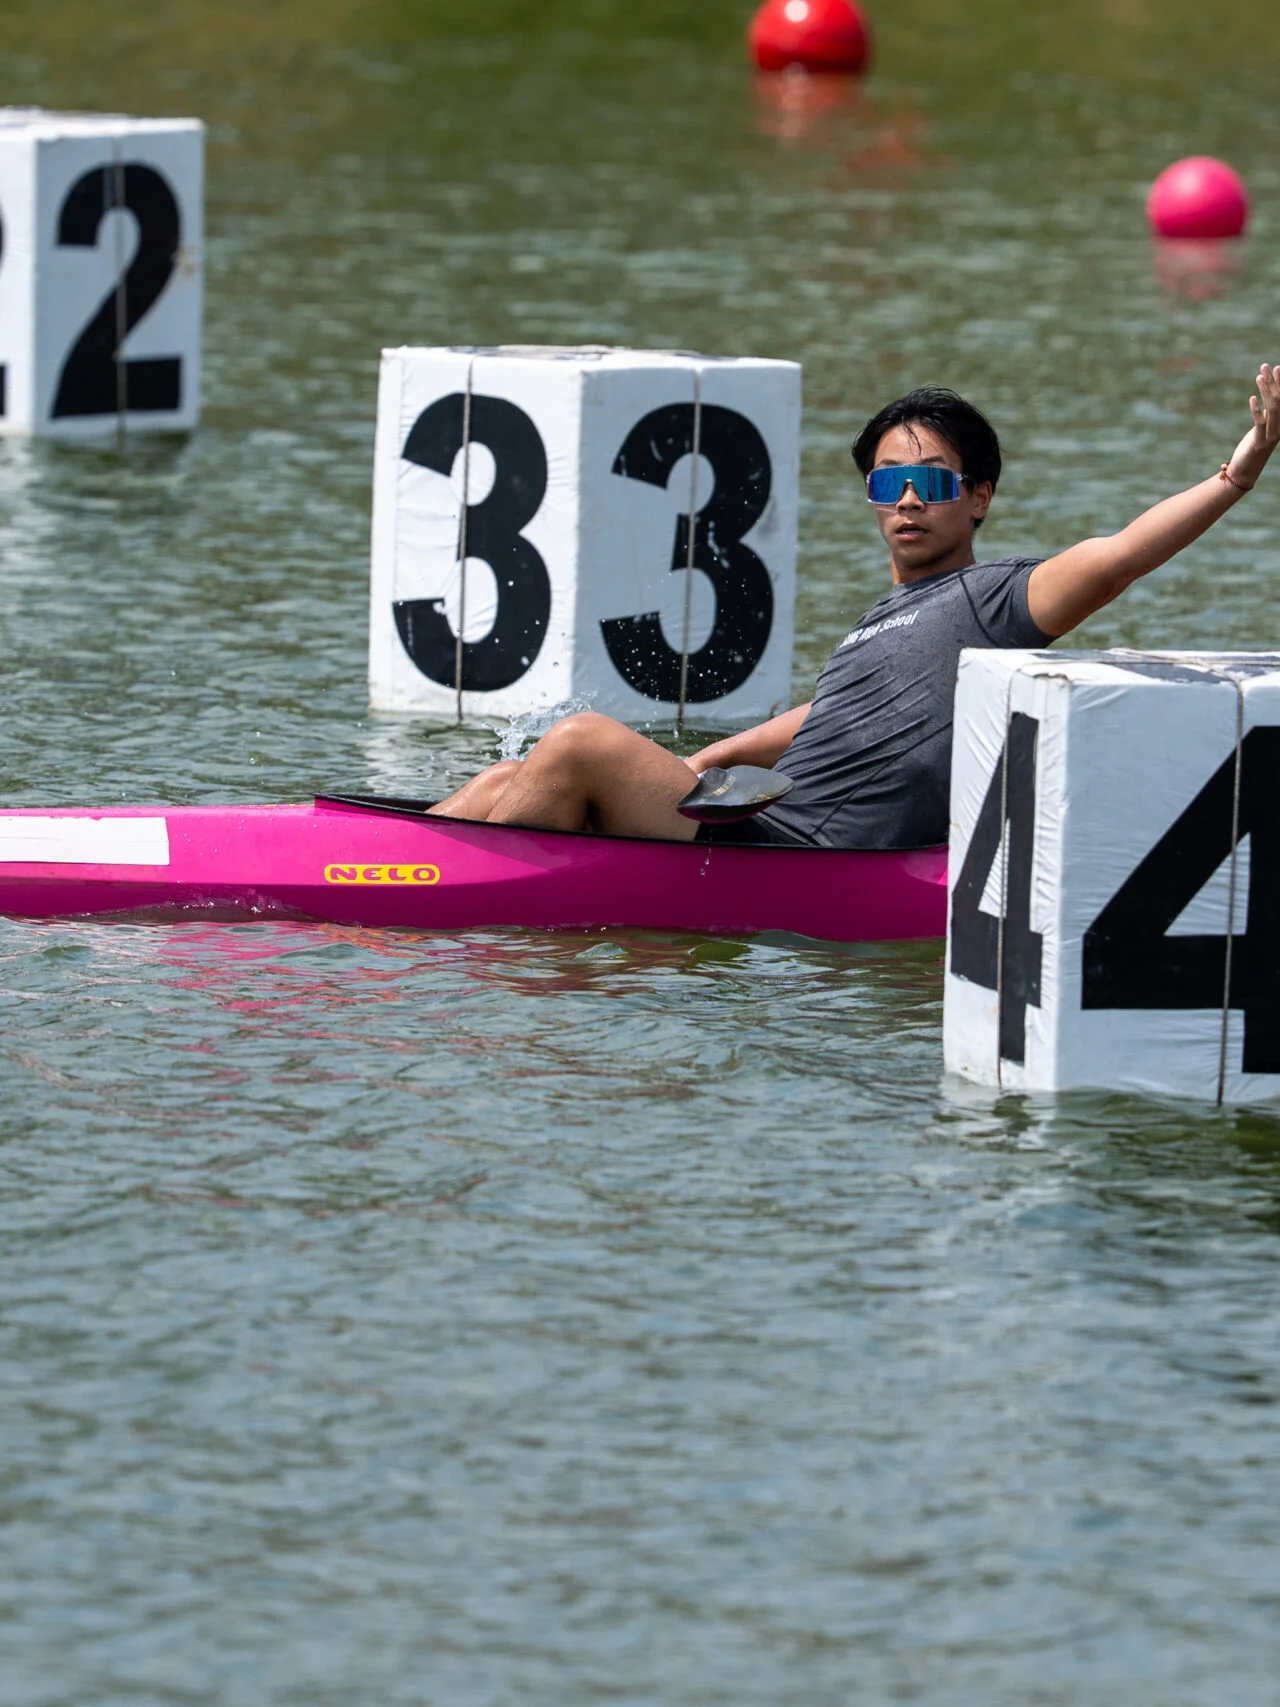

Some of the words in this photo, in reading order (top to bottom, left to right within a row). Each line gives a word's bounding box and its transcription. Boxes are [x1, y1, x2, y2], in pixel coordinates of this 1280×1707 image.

[51, 162, 181, 418] 2
[392, 392, 552, 692] 3
[600, 402, 774, 703] 3
[329, 866, 437, 882] NELO
[951, 712, 1043, 1064] 4
